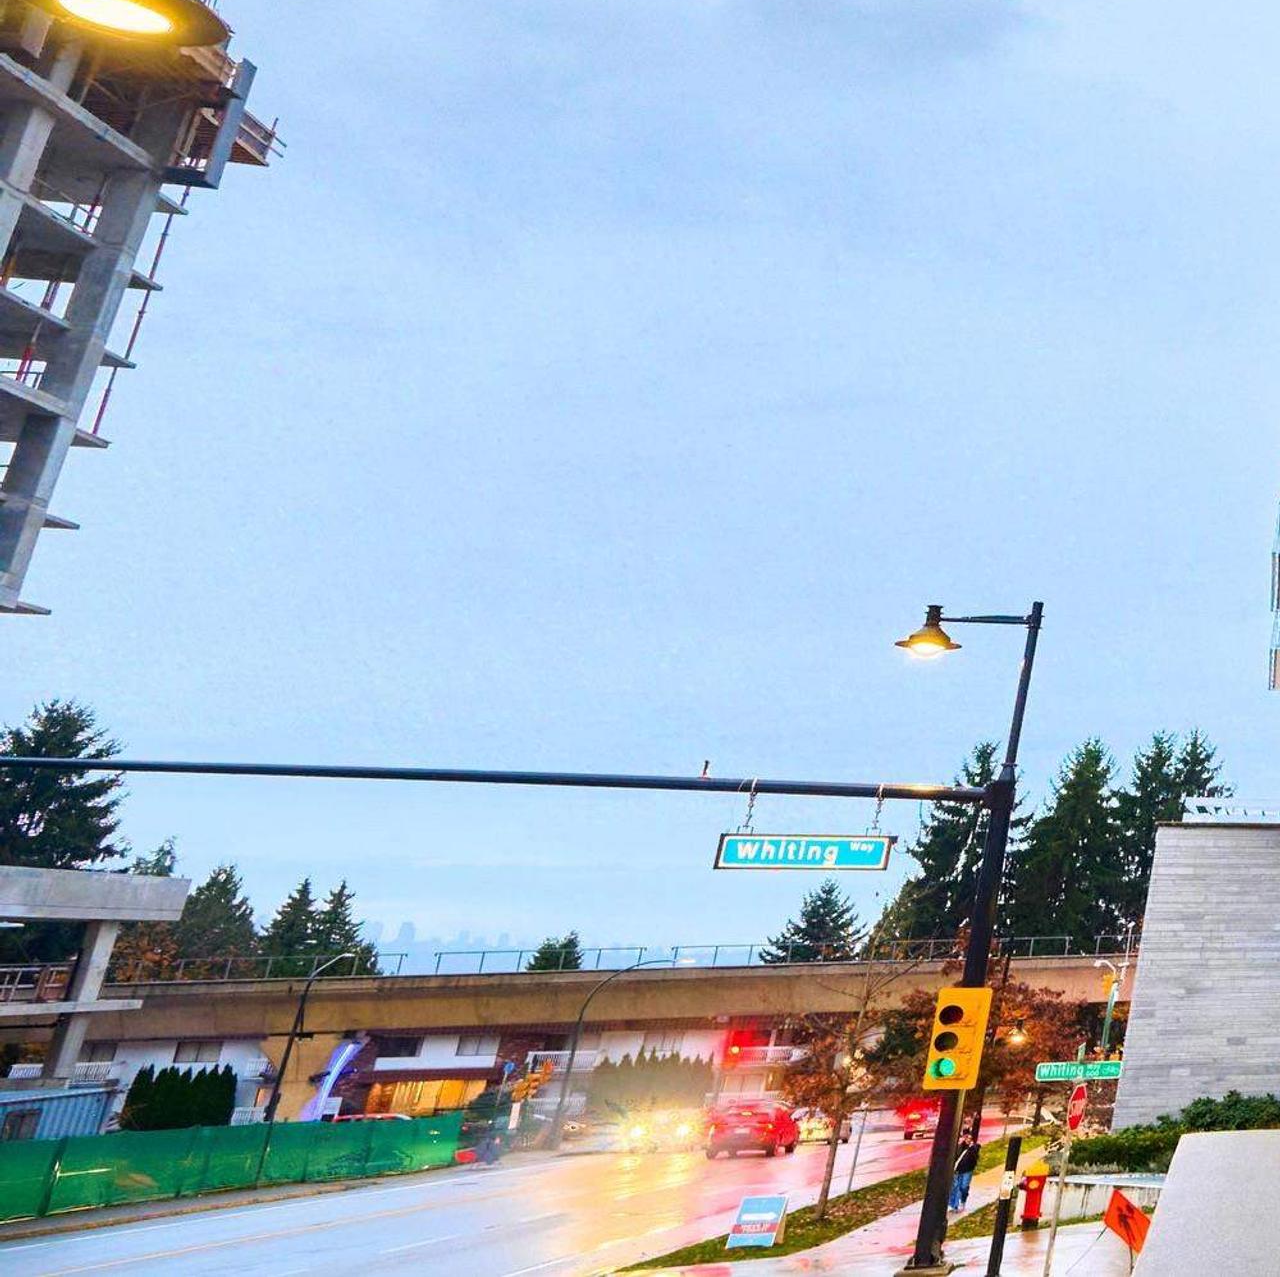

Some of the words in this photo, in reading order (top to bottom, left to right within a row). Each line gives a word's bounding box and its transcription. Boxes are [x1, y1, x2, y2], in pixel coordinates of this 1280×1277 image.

[737, 841, 839, 866] Whiting
[849, 841, 874, 853] Way
[1040, 1065, 1084, 1078] Whiting
